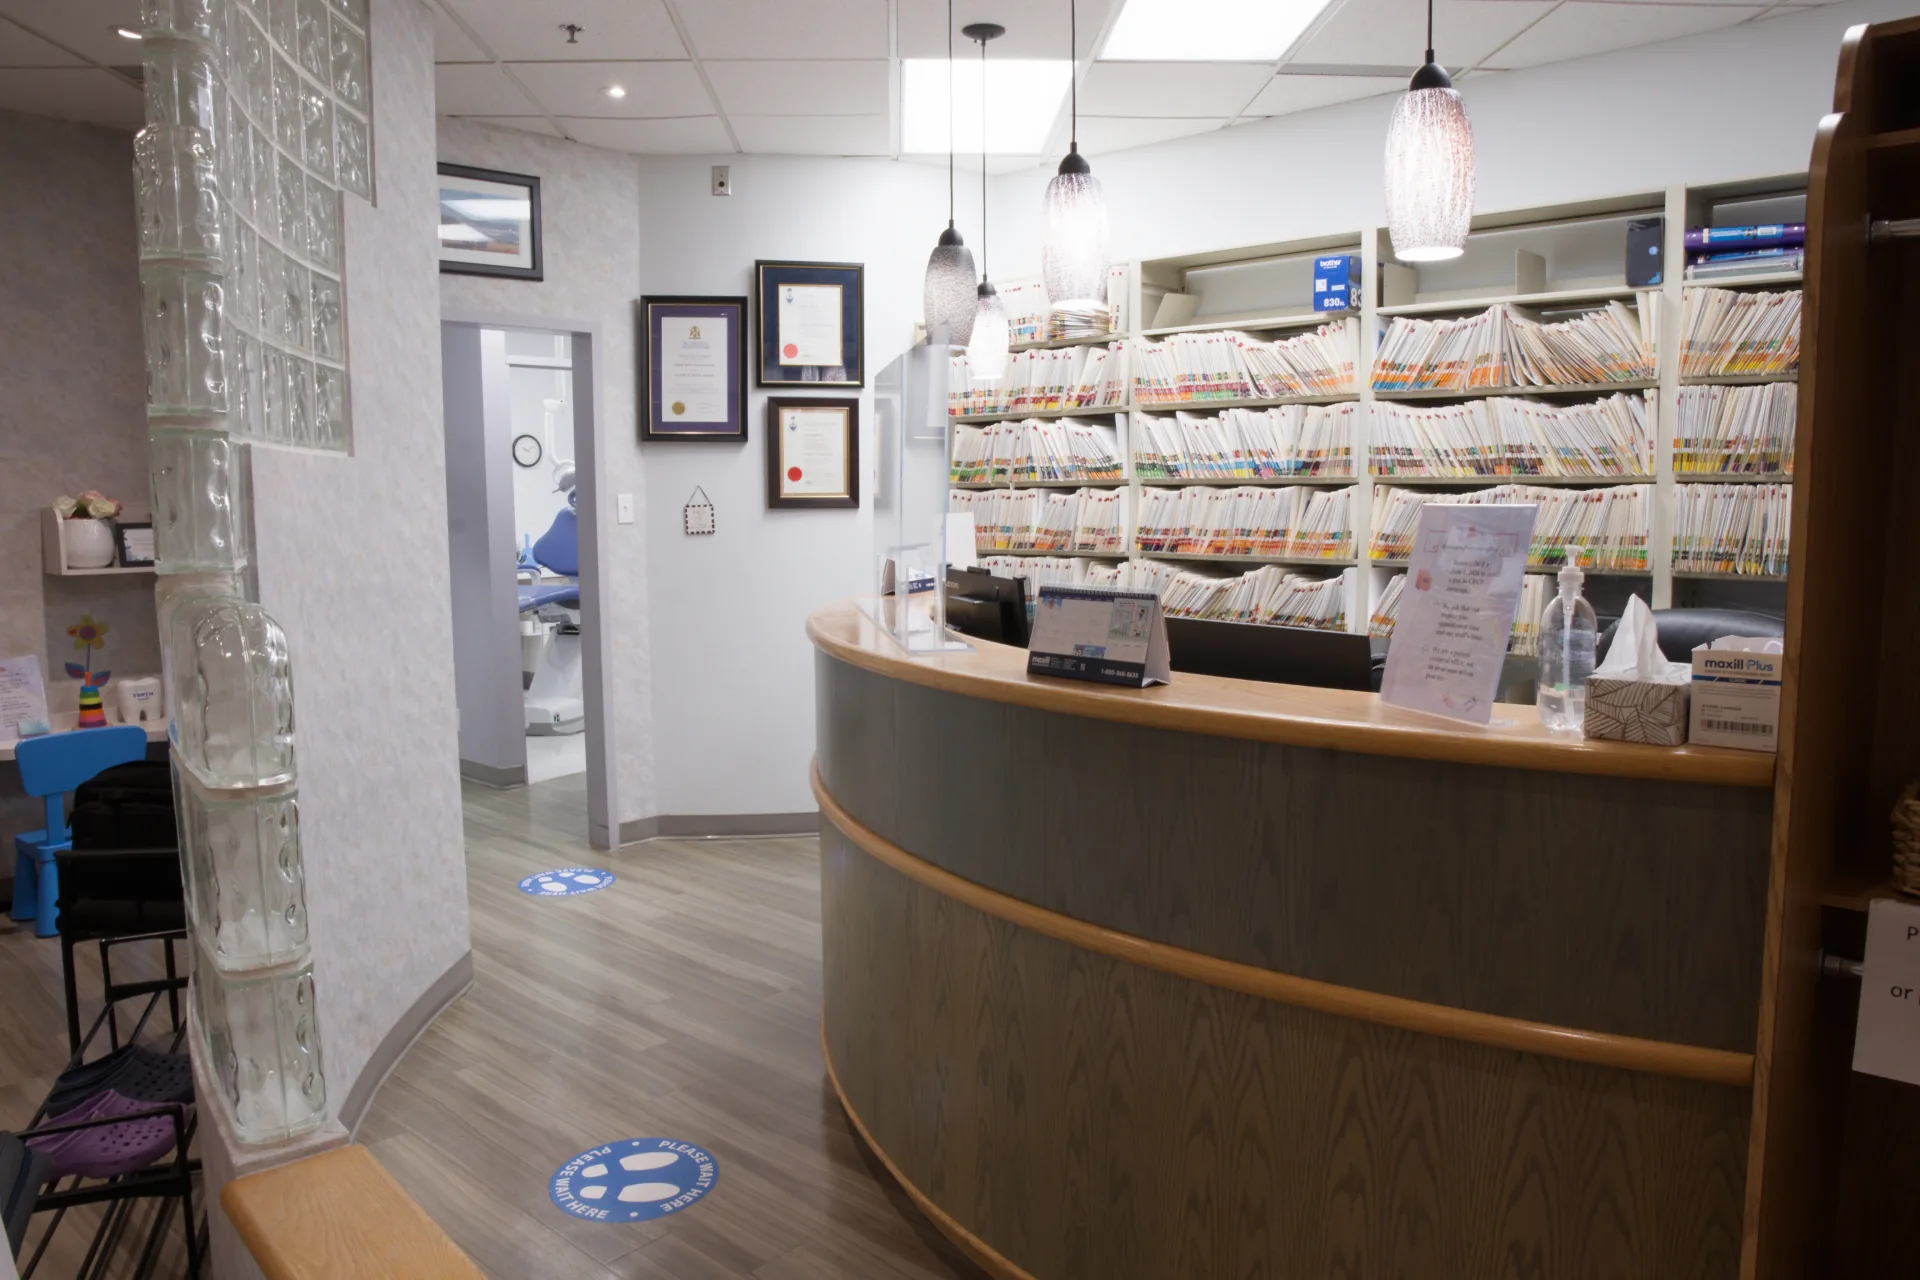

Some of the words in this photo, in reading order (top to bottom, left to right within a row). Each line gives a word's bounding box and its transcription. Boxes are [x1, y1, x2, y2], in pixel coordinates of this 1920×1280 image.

[1705, 659, 1743, 670] maxill
[1747, 659, 1774, 671] Plus
[1890, 985, 1913, 1001] or
[559, 1145, 612, 1177] PLEASE
[658, 1140, 708, 1164] PLEASE
[698, 1162, 714, 1188] WAIT
[554, 1177, 571, 1202] WAIT
[659, 1188, 703, 1212] HERE
[566, 1200, 610, 1219] HERE
